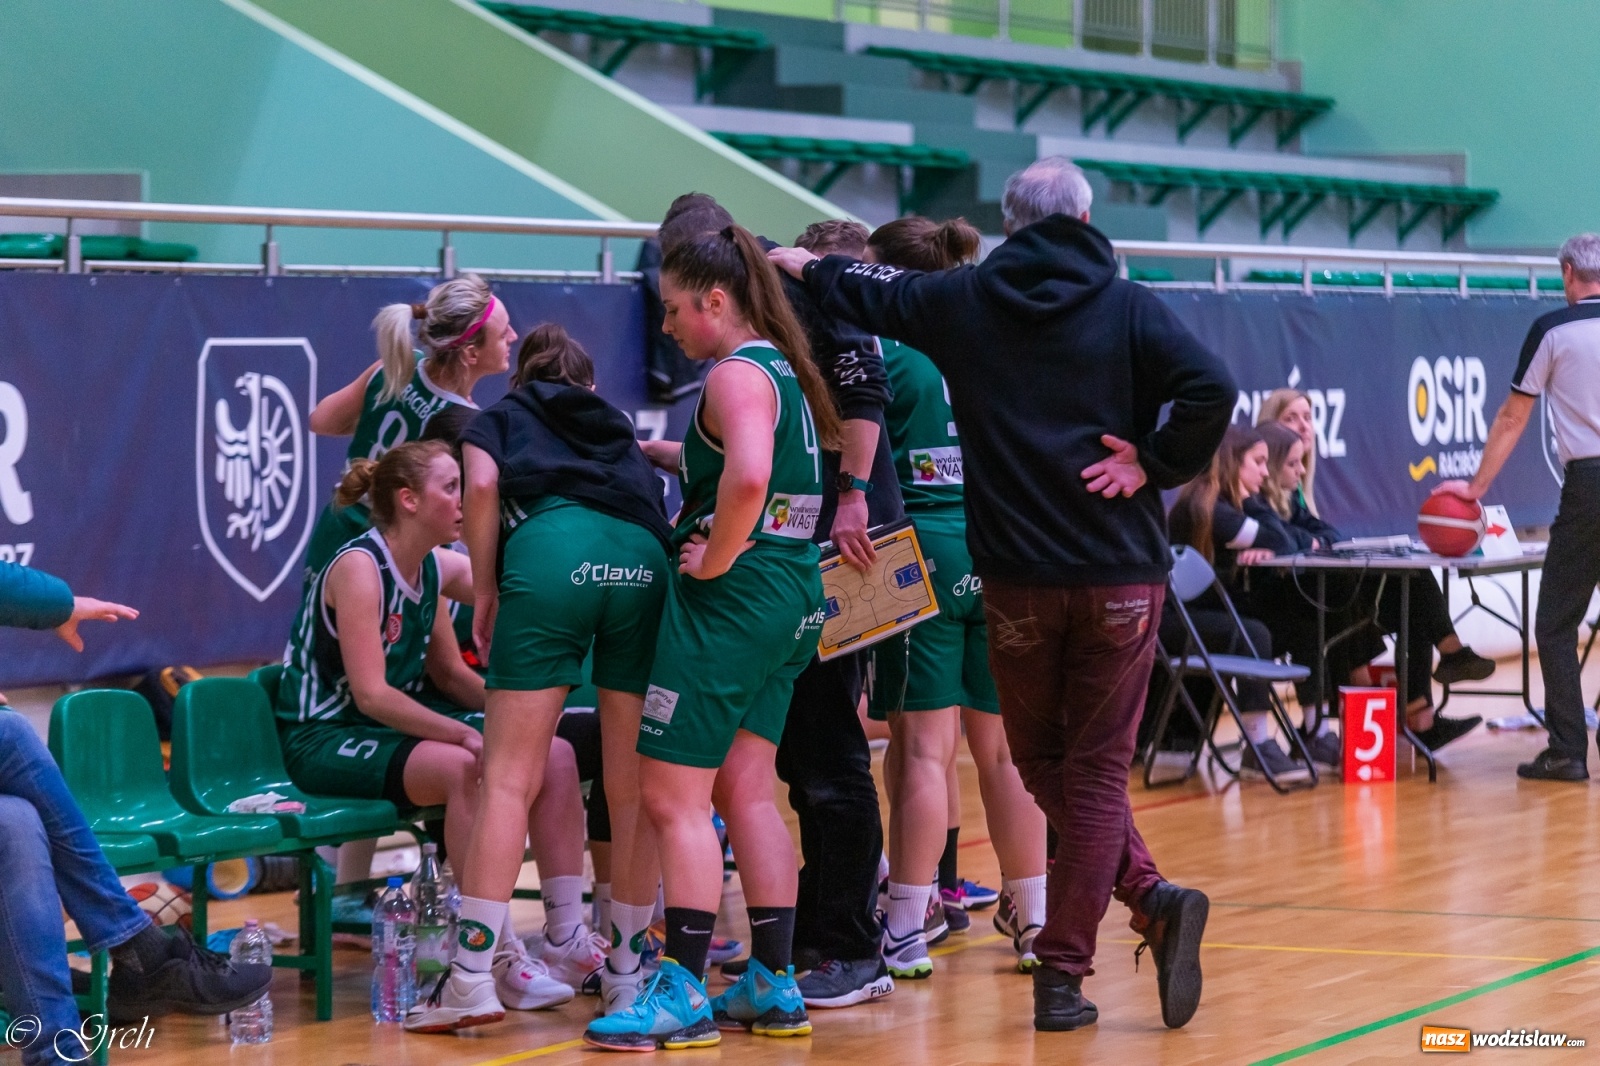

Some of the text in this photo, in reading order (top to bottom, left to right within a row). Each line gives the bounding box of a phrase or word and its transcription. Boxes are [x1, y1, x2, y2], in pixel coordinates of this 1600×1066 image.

[1408, 355, 1488, 446] OSiR
[592, 563, 654, 583] Clavis
[1354, 698, 1388, 763] 5
[336, 738, 379, 760] 5
[870, 982, 892, 997] FILA
